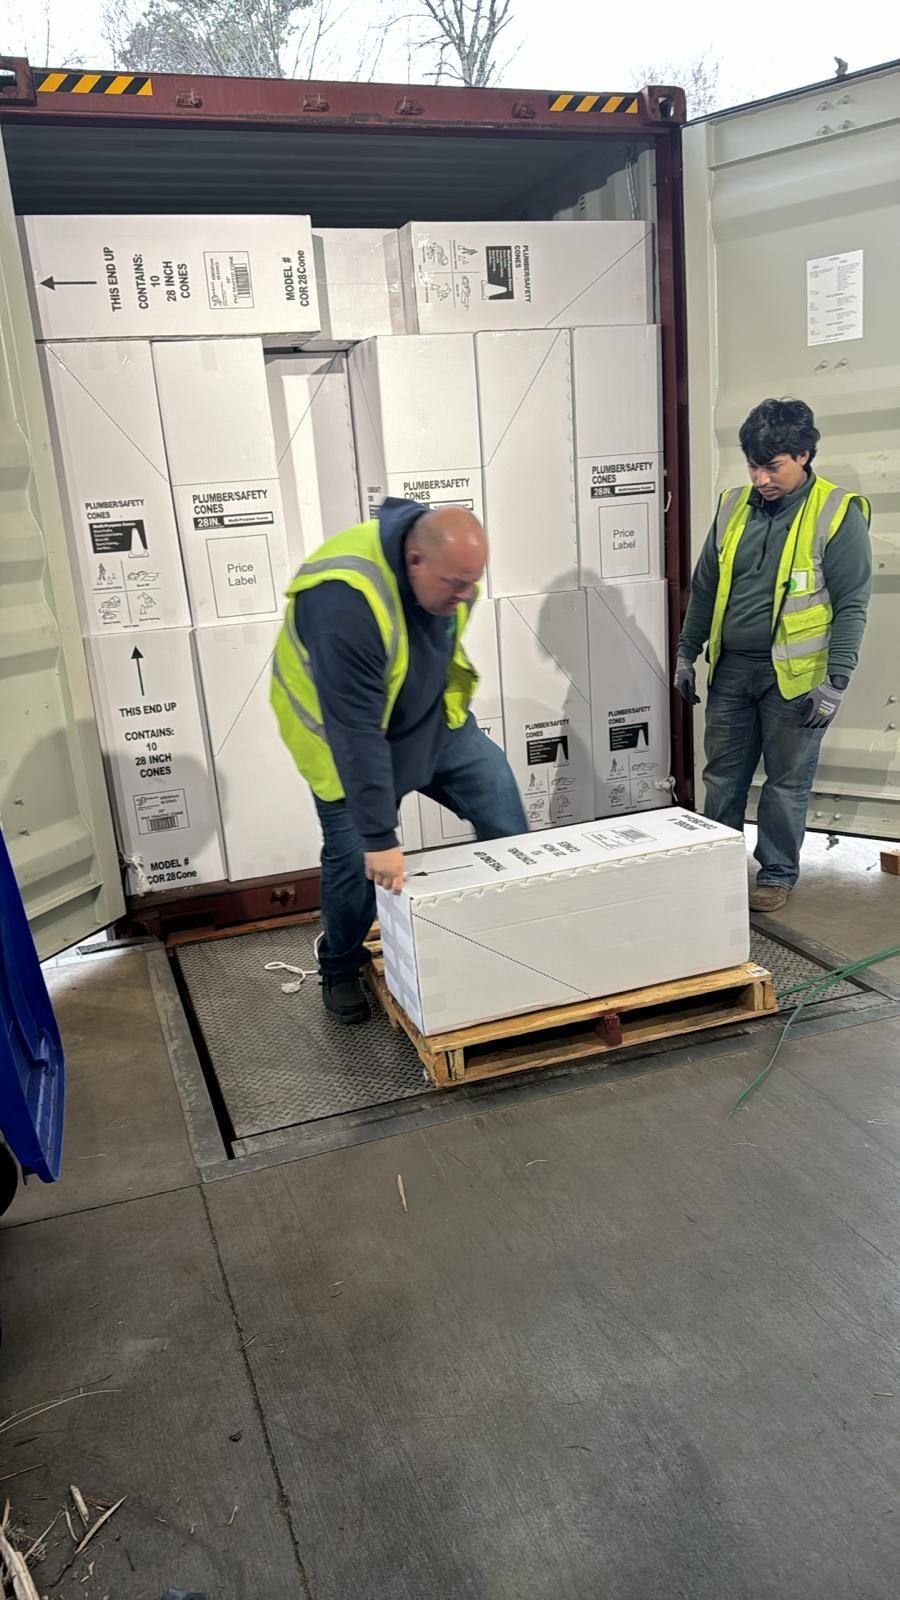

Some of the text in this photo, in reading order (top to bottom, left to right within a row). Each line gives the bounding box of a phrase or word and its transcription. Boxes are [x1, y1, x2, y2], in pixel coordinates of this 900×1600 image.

[103, 246, 122, 312] THIS END UP
[133, 253, 149, 309] CONTAINS:
[151, 275, 161, 287] 10
[162, 261, 177, 302] 28 INCH
[177, 263, 191, 299] CONES
[281, 256, 296, 301] MODEL #
[592, 474, 616, 484] CONES
[404, 491, 431, 501] CONES
[194, 503, 224, 514] CONES
[87, 511, 111, 519] CONES
[613, 529, 635, 538] Price
[612, 540, 636, 550] Label
[227, 563, 254, 574] Price
[227, 575, 257, 587] Label
[119, 702, 177, 718] THIS END UP
[608, 717, 625, 725] CONES
[125, 727, 174, 741] CONTAINS:
[525, 731, 543, 739] CONES
[146, 742, 157, 751] 10
[135, 753, 172, 766] 28 INCH
[140, 766, 171, 778] CONES
[150, 857, 190, 871] MODEL #
